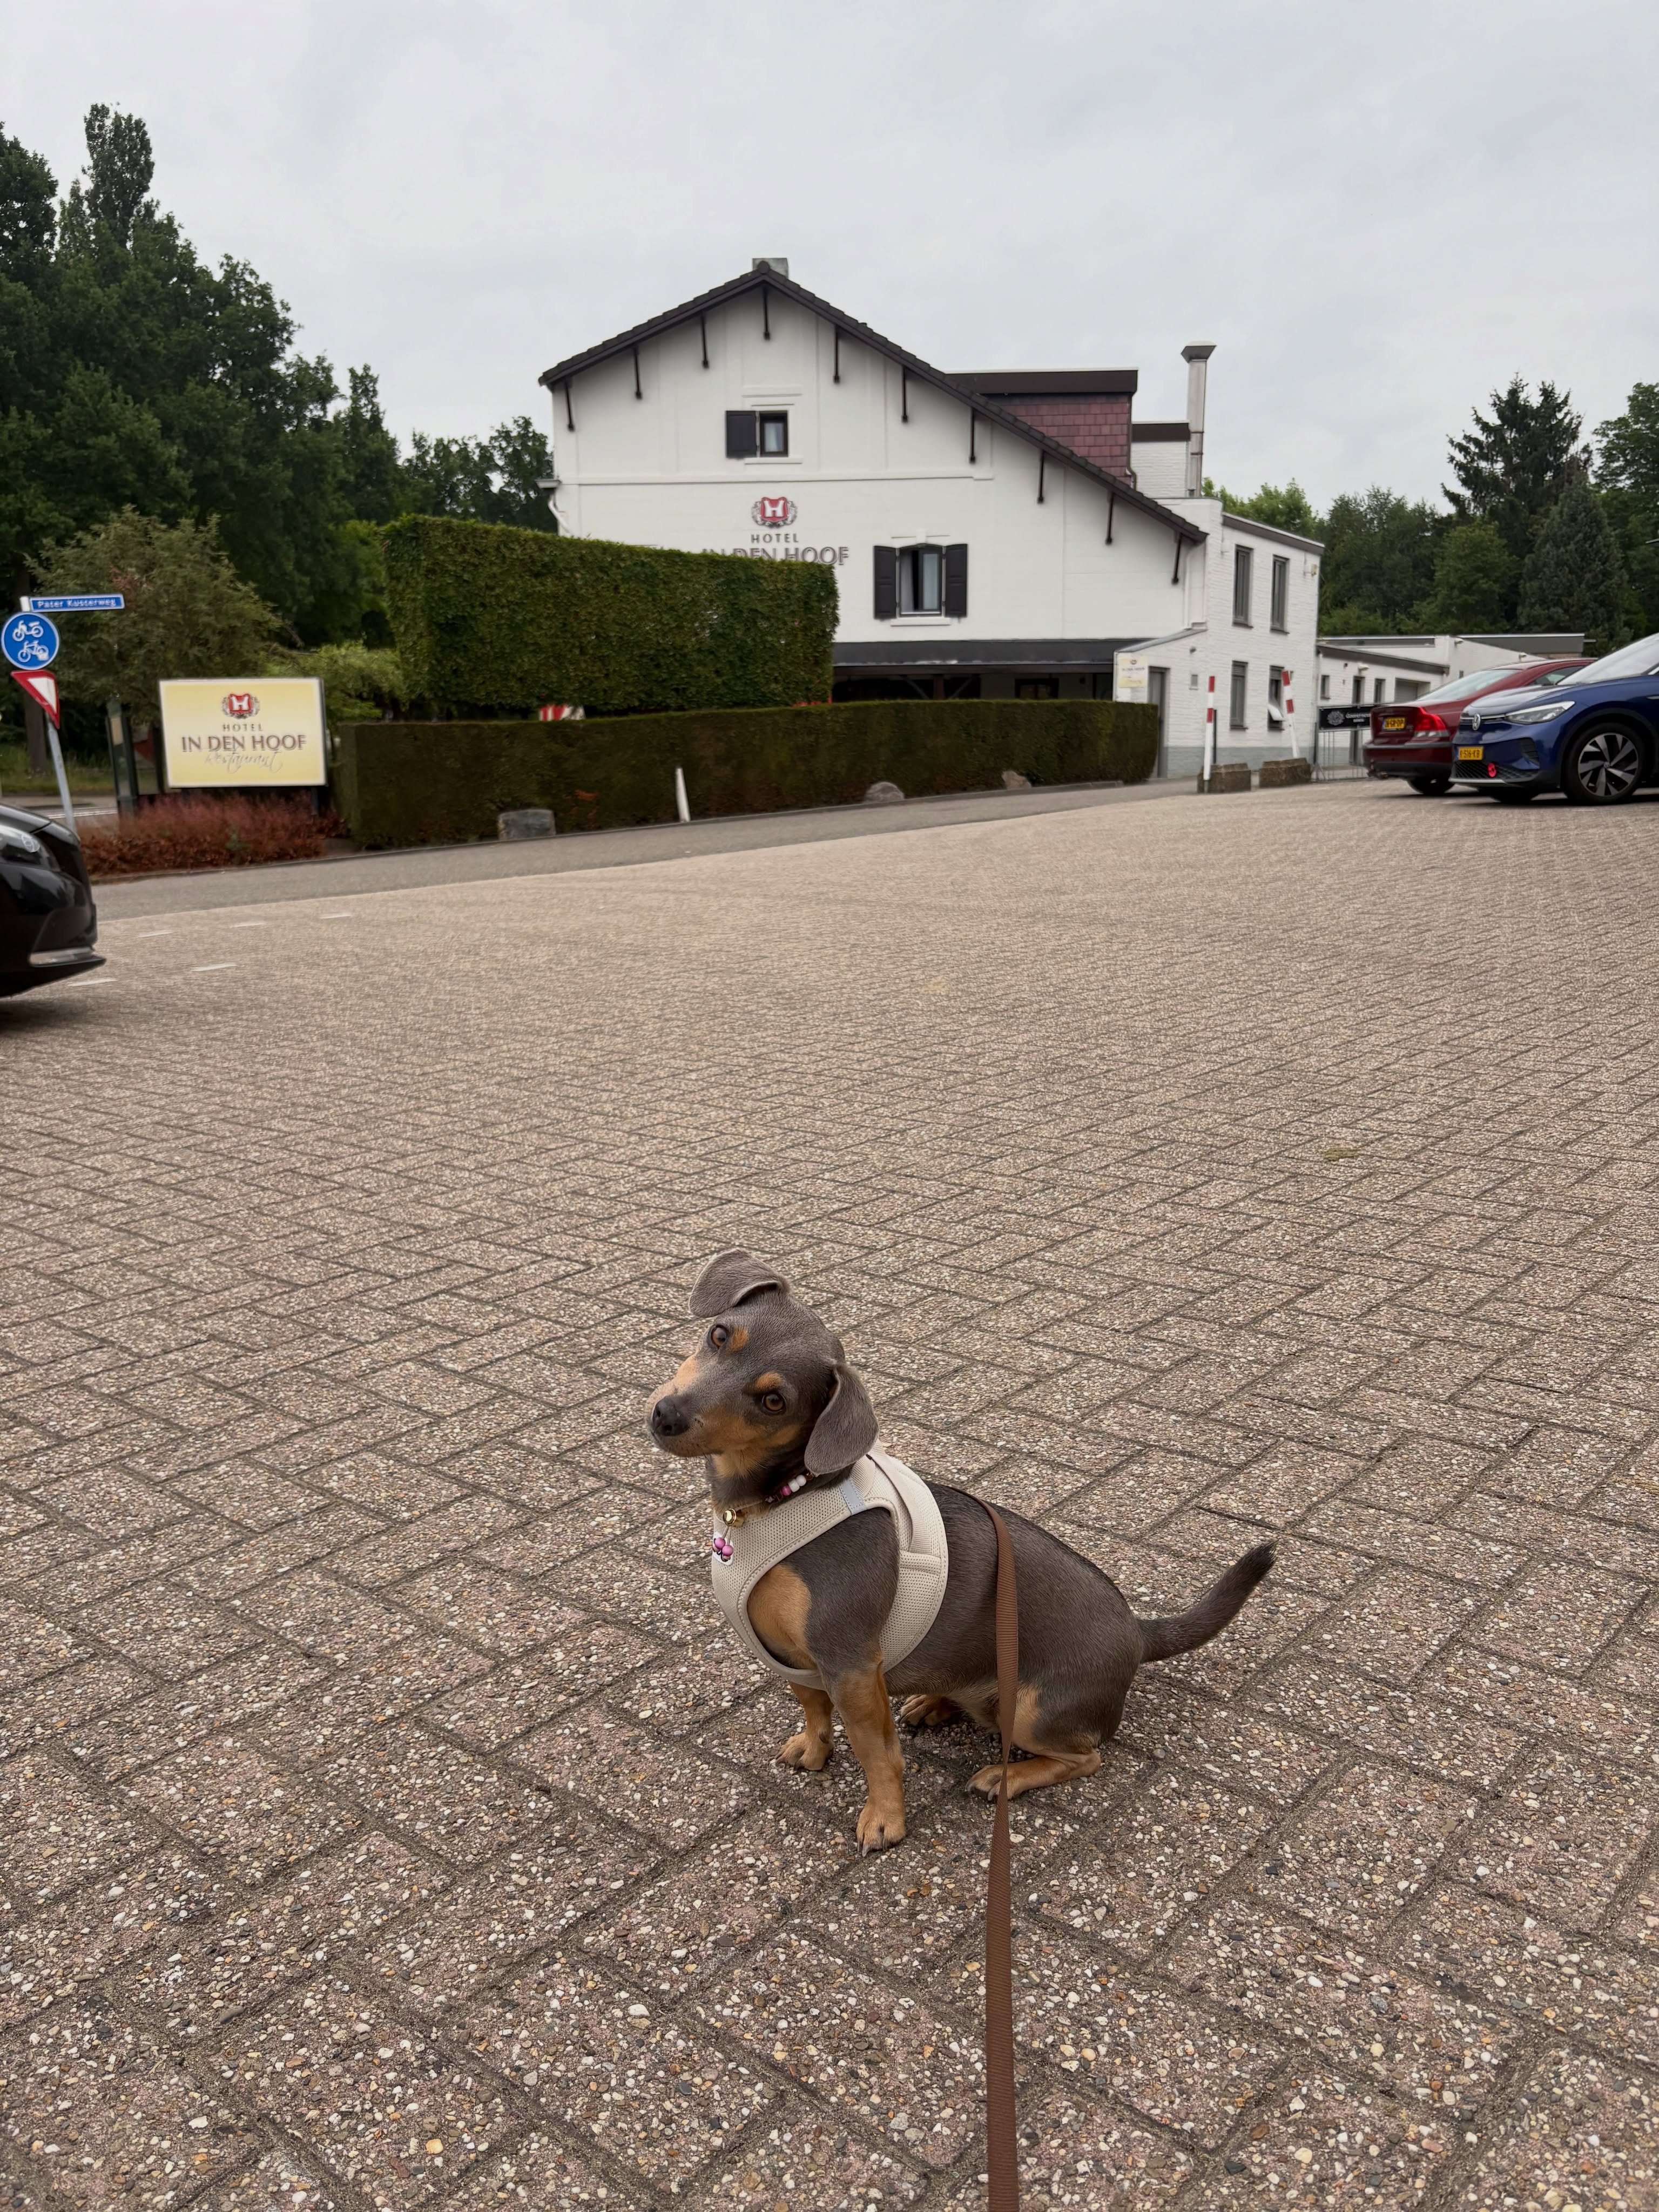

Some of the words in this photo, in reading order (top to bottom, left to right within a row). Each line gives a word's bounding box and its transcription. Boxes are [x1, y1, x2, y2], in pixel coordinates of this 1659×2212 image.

[751, 533, 799, 543] HOTEL
[785, 547, 849, 565] HOOF
[222, 724, 264, 732] HOTEL
[181, 736, 201, 752] IN
[208, 736, 245, 752] DEN
[252, 734, 306, 751] HOOF
[205, 751, 283, 774] Restaurant
